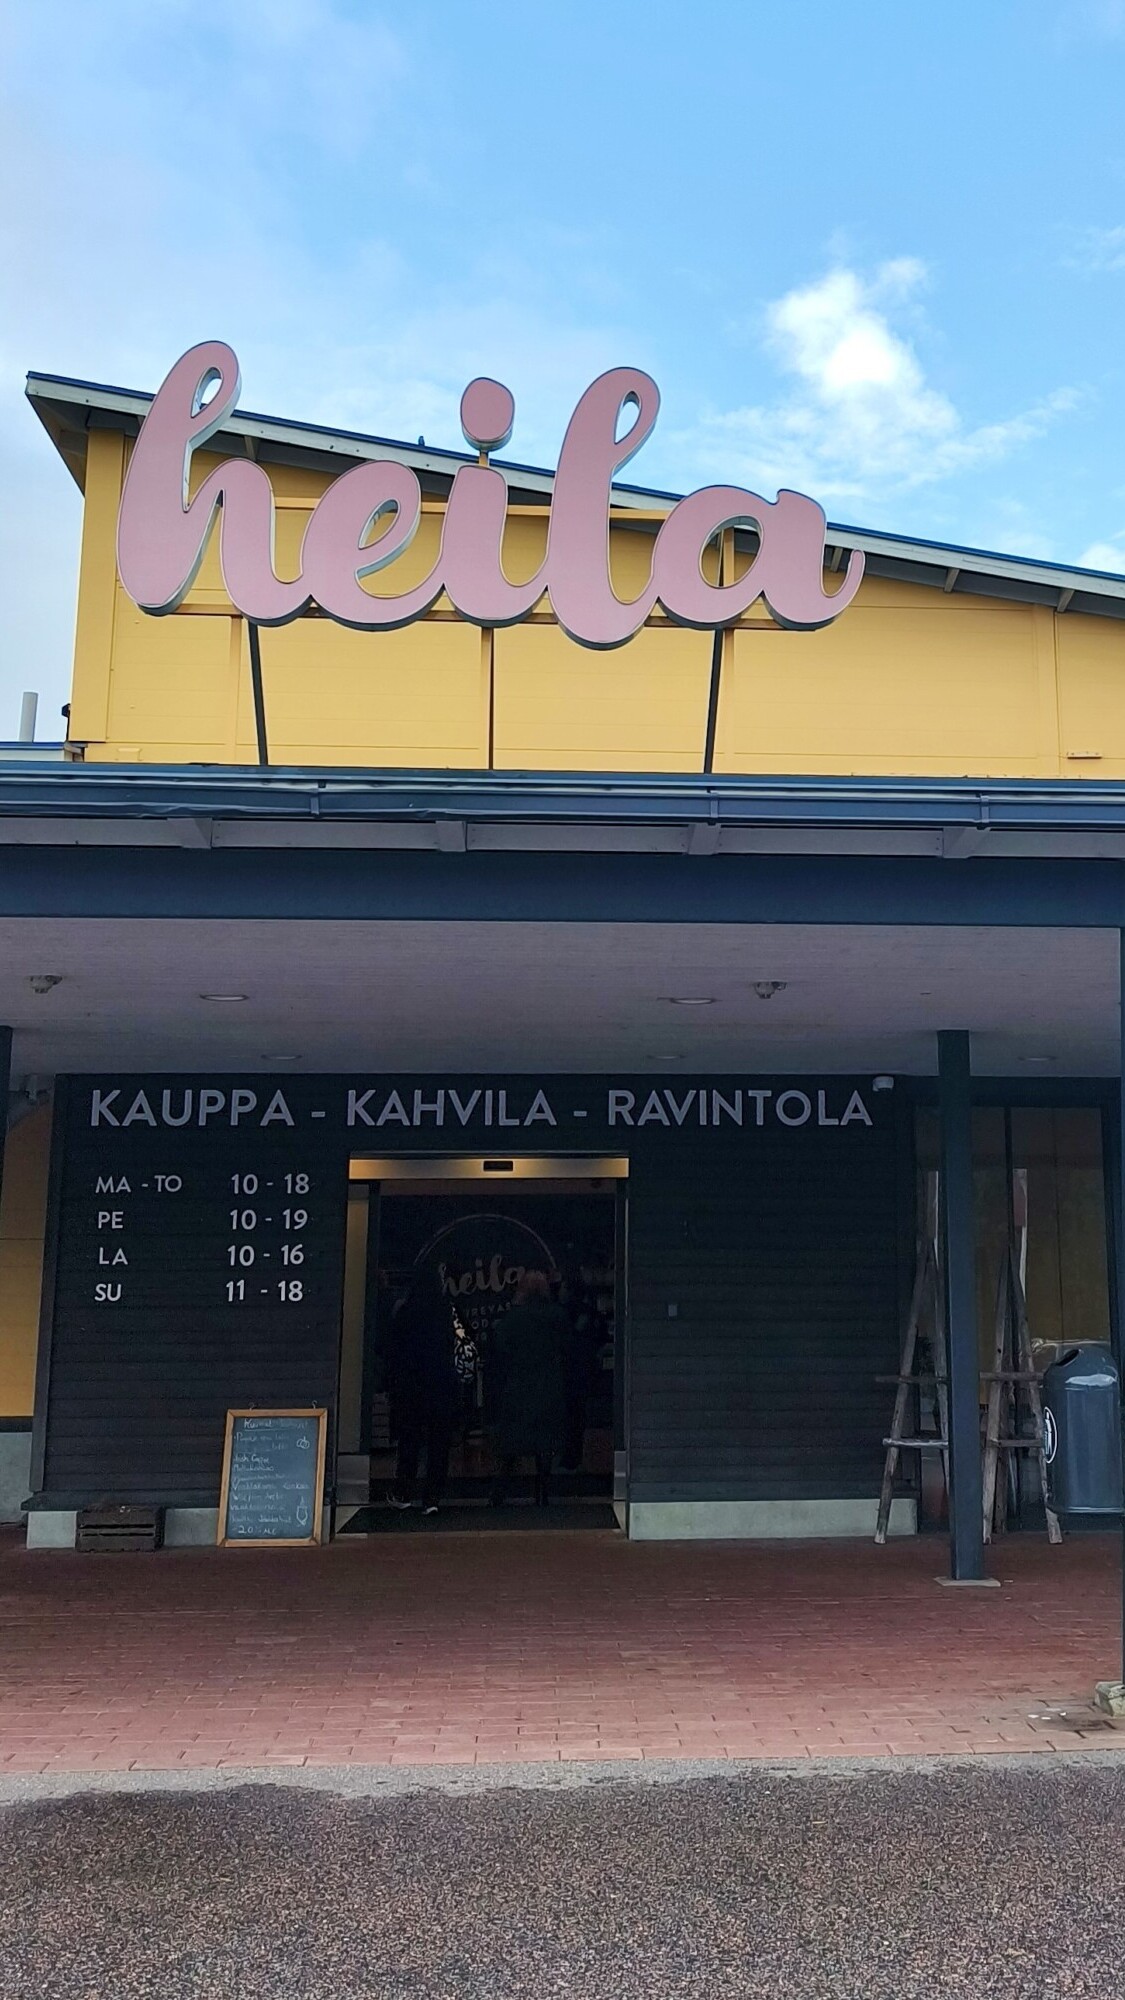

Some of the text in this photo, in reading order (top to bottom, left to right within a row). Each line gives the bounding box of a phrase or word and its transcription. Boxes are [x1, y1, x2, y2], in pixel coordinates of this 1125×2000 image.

[116, 340, 865, 650] heila
[91, 1089, 295, 1127] KAUPPA
[346, 1089, 557, 1127] KAHVILA
[573, 1110, 588, 1118] -
[607, 1089, 874, 1127] RAVINTOLA
[95, 1175, 132, 1194] MA
[154, 1174, 182, 1193] TO
[230, 1173, 258, 1195] 10
[284, 1173, 310, 1195] 18
[97, 1211, 125, 1229] PE
[229, 1209, 257, 1230] 10
[281, 1208, 308, 1230] 19
[98, 1247, 129, 1266] LA
[227, 1245, 255, 1267] 10
[280, 1244, 305, 1266] 16
[94, 1283, 122, 1302] SU
[226, 1279, 246, 1301] 11
[277, 1279, 303, 1302] 18
